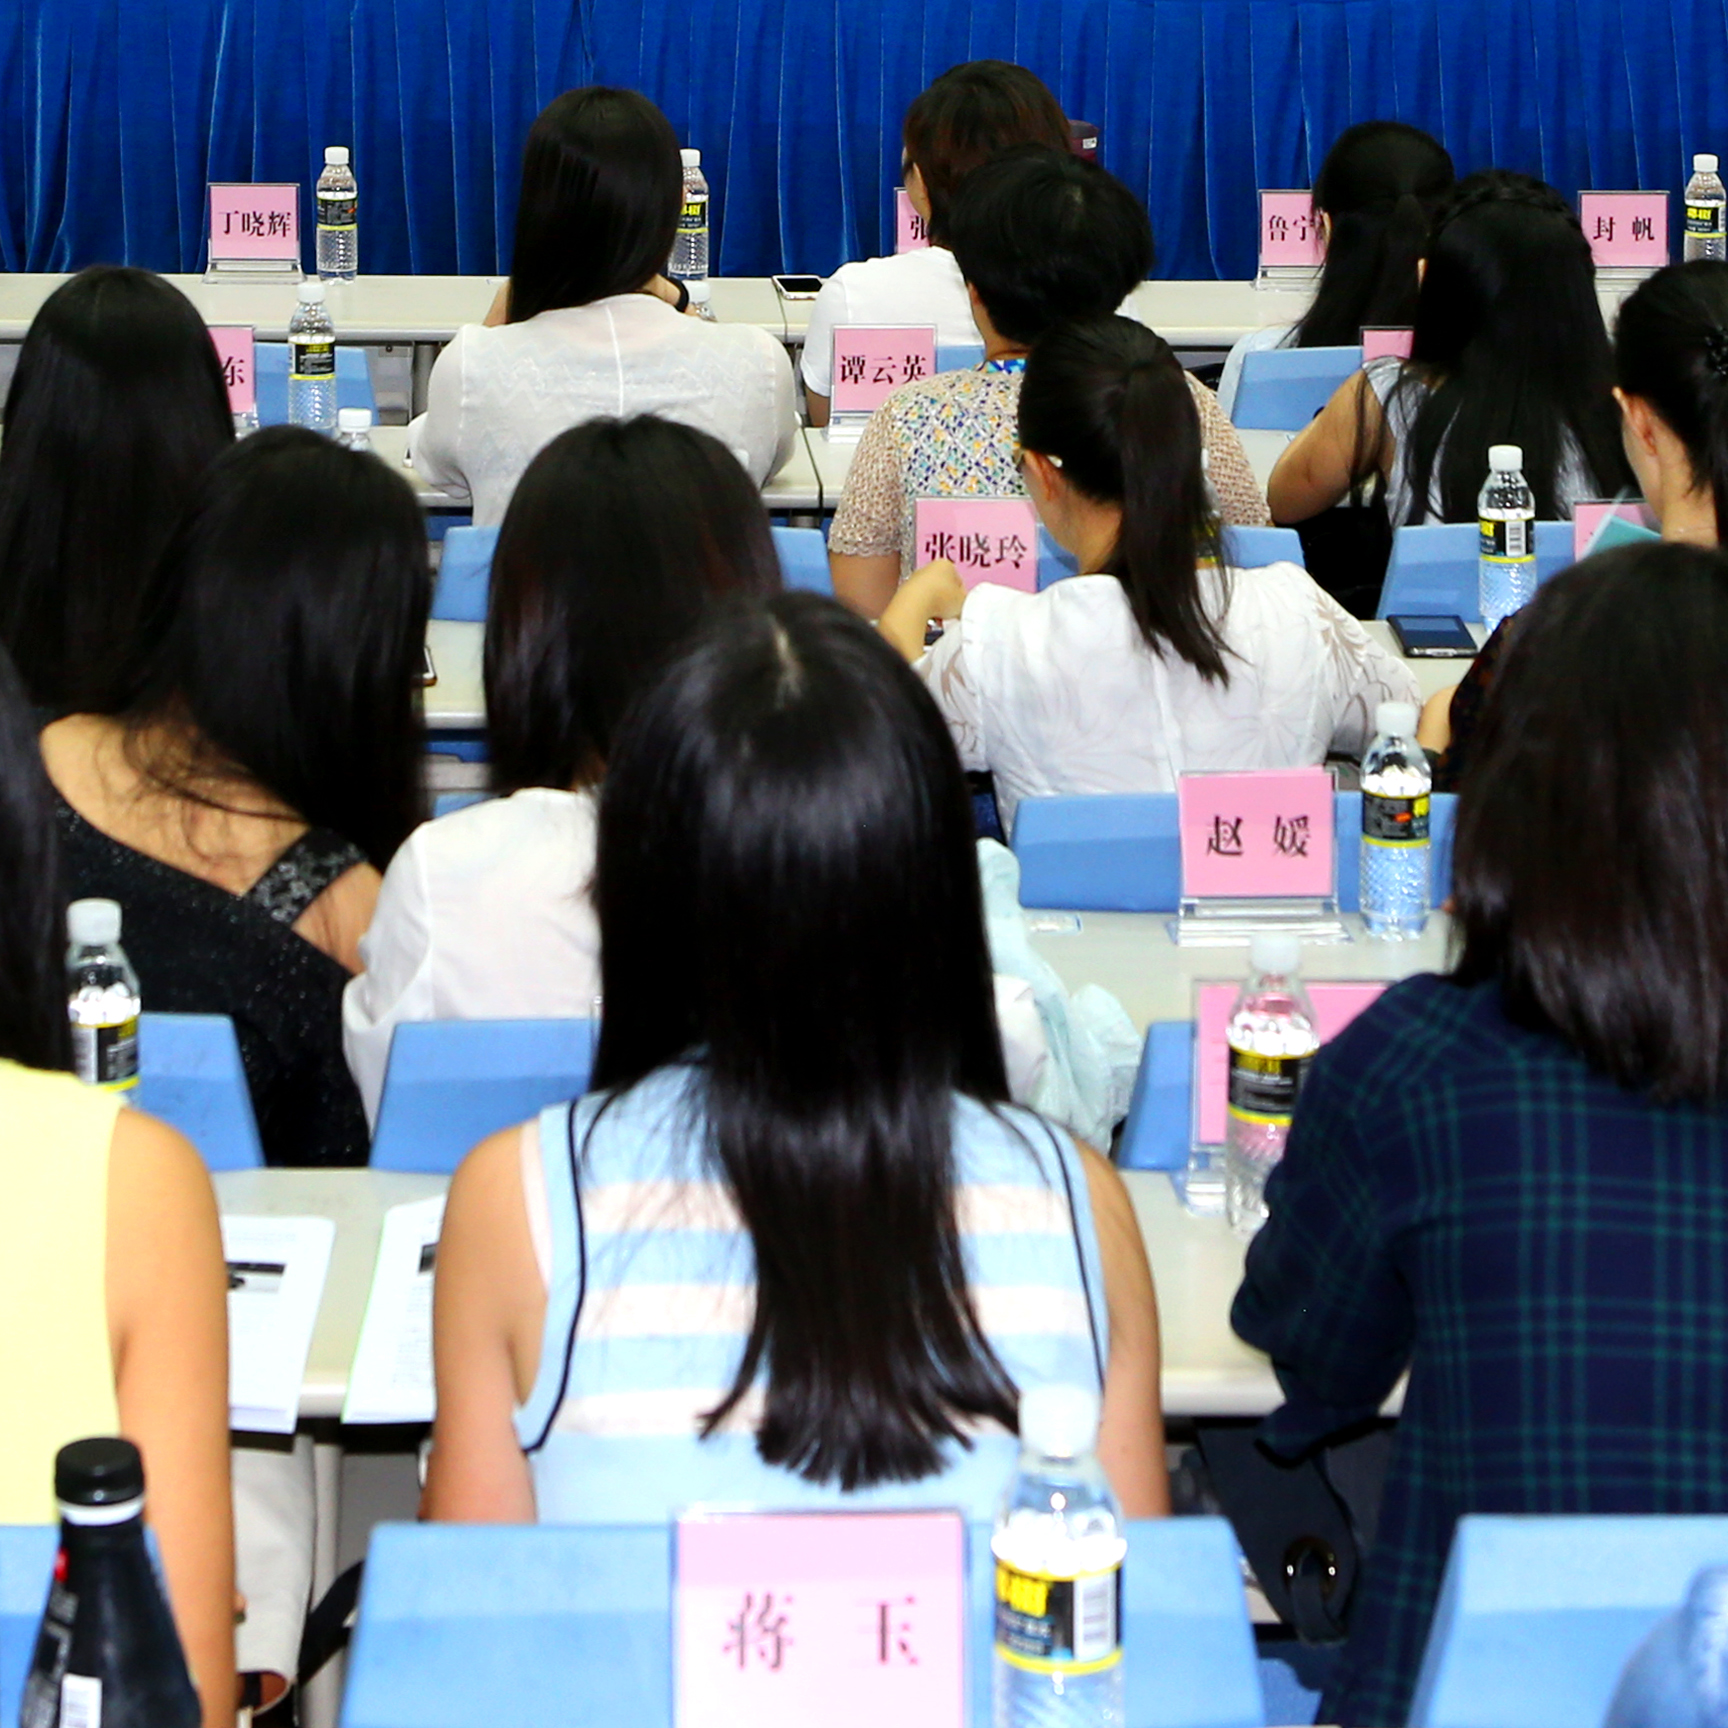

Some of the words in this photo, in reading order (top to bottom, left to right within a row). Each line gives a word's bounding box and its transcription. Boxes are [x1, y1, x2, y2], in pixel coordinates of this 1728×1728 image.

[220, 209, 291, 238] 丁晓辉
[1593, 216, 1656, 242] 封帆
[840, 352, 927, 385] 谭云英
[924, 531, 1028, 571] 张晓玲
[1205, 814, 1311, 858] 赵媛
[723, 1593, 920, 1671] 蒋玉
